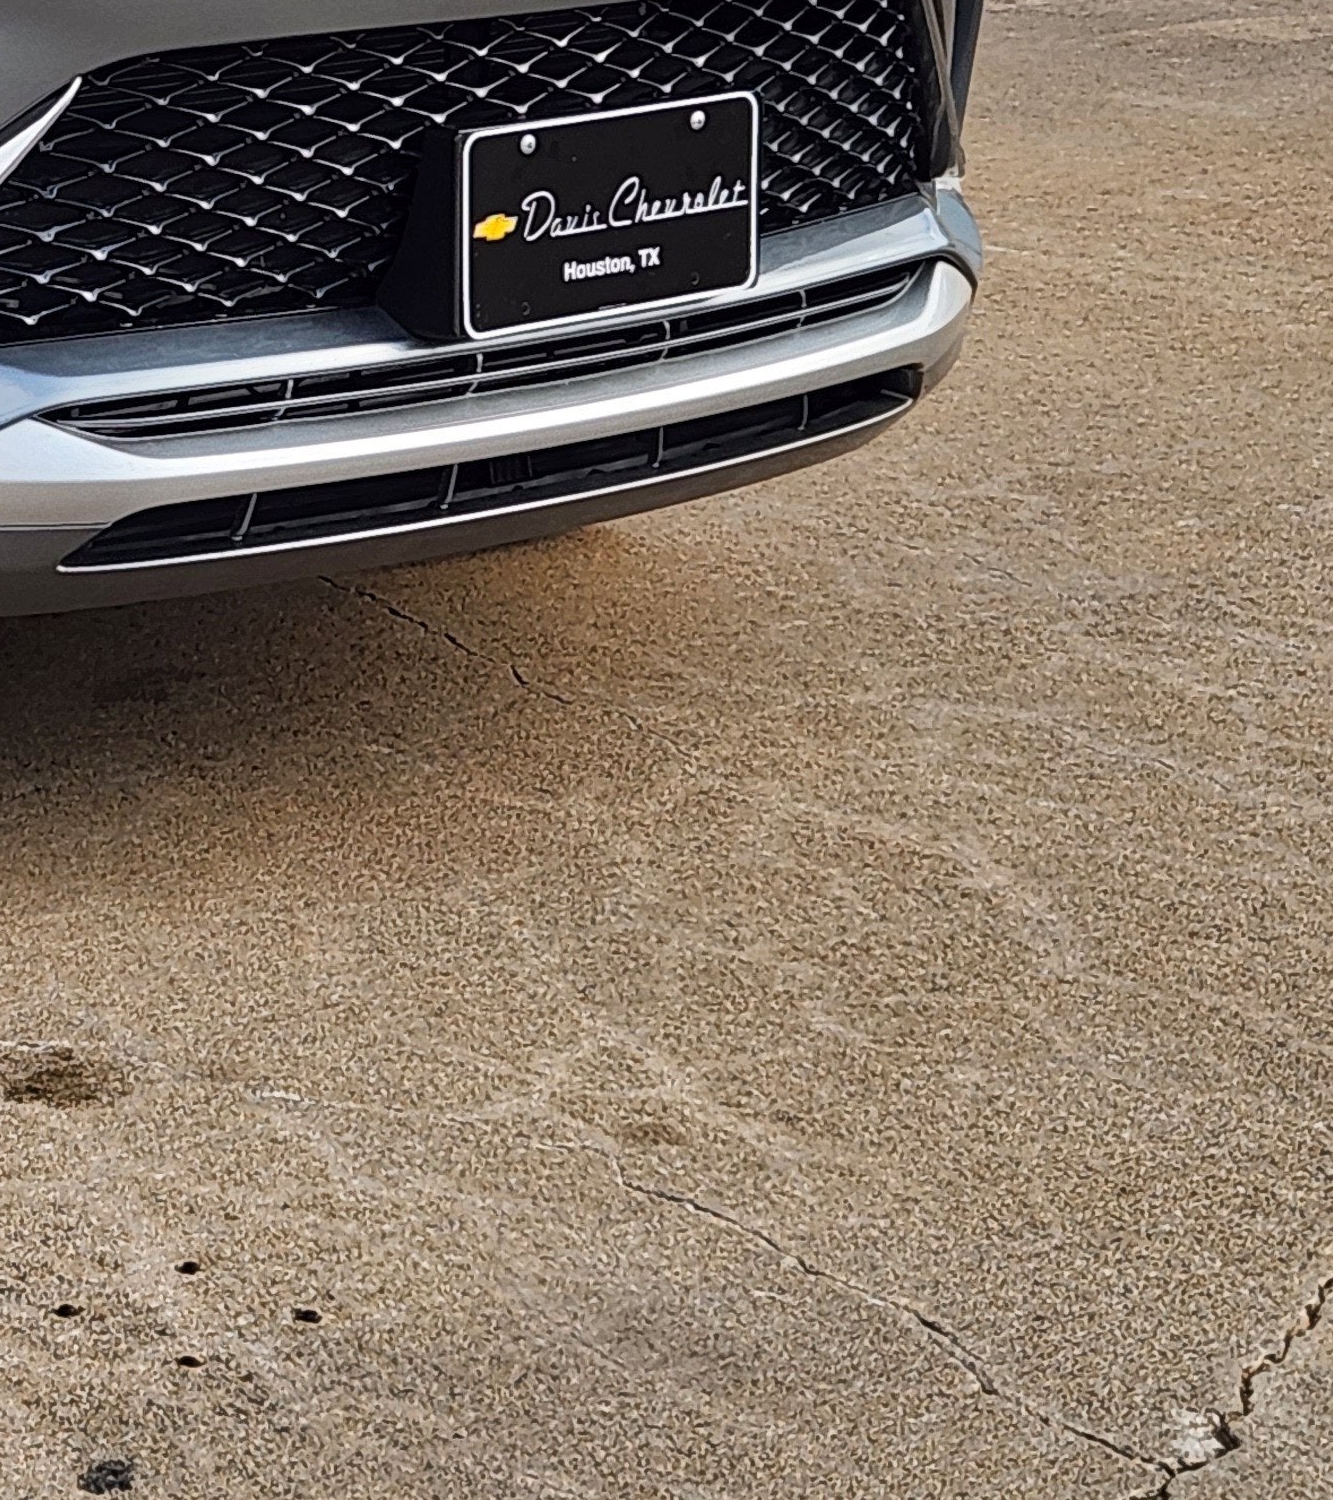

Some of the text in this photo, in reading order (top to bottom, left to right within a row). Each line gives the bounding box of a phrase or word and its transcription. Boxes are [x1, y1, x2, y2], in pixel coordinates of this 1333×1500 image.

[521, 176, 749, 242] Davis Chevrolet
[563, 246, 661, 282] Houston, TX
